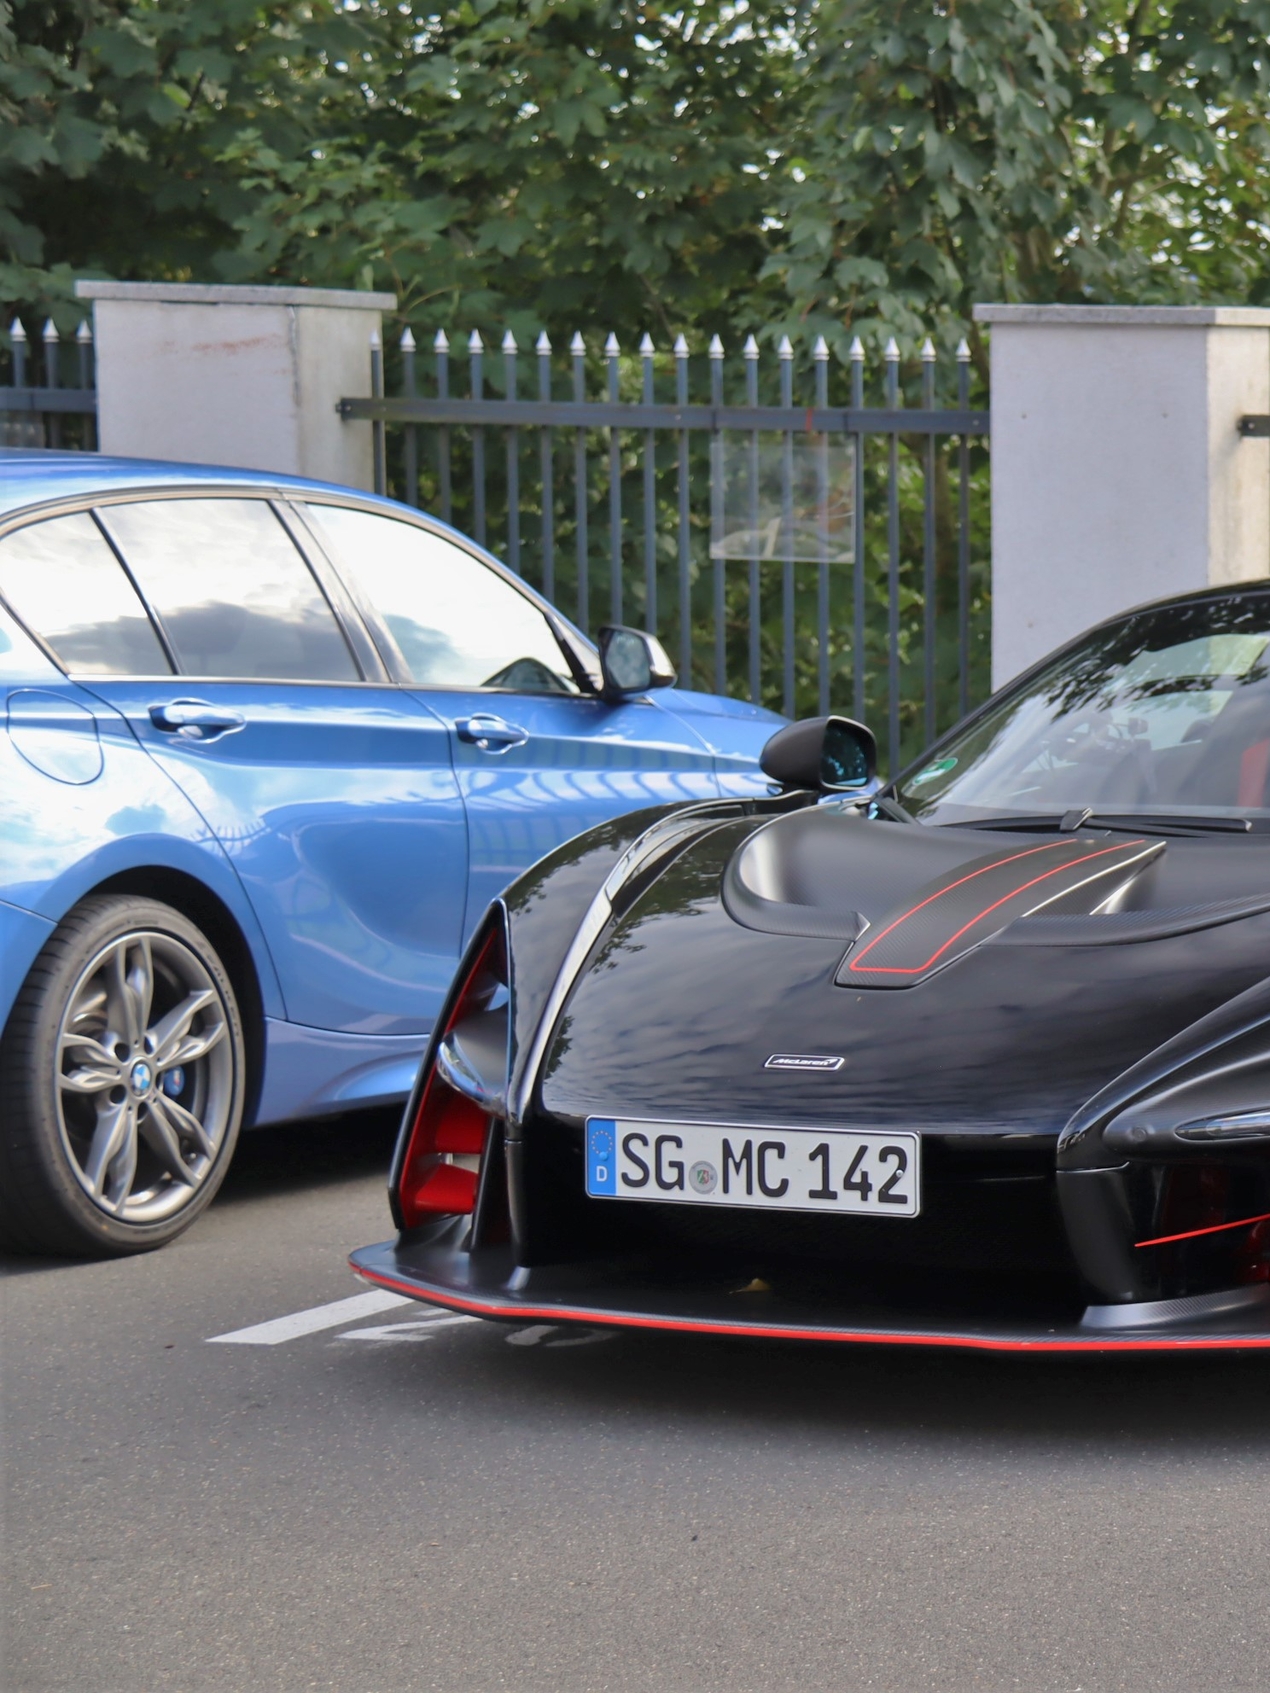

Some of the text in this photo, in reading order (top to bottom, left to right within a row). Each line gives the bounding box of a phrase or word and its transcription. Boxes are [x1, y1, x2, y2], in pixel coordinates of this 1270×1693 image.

[596, 1166, 608, 1182] D
[621, 1132, 685, 1191] SG
[722, 1138, 789, 1198] MC
[808, 1143, 908, 1205] 142
